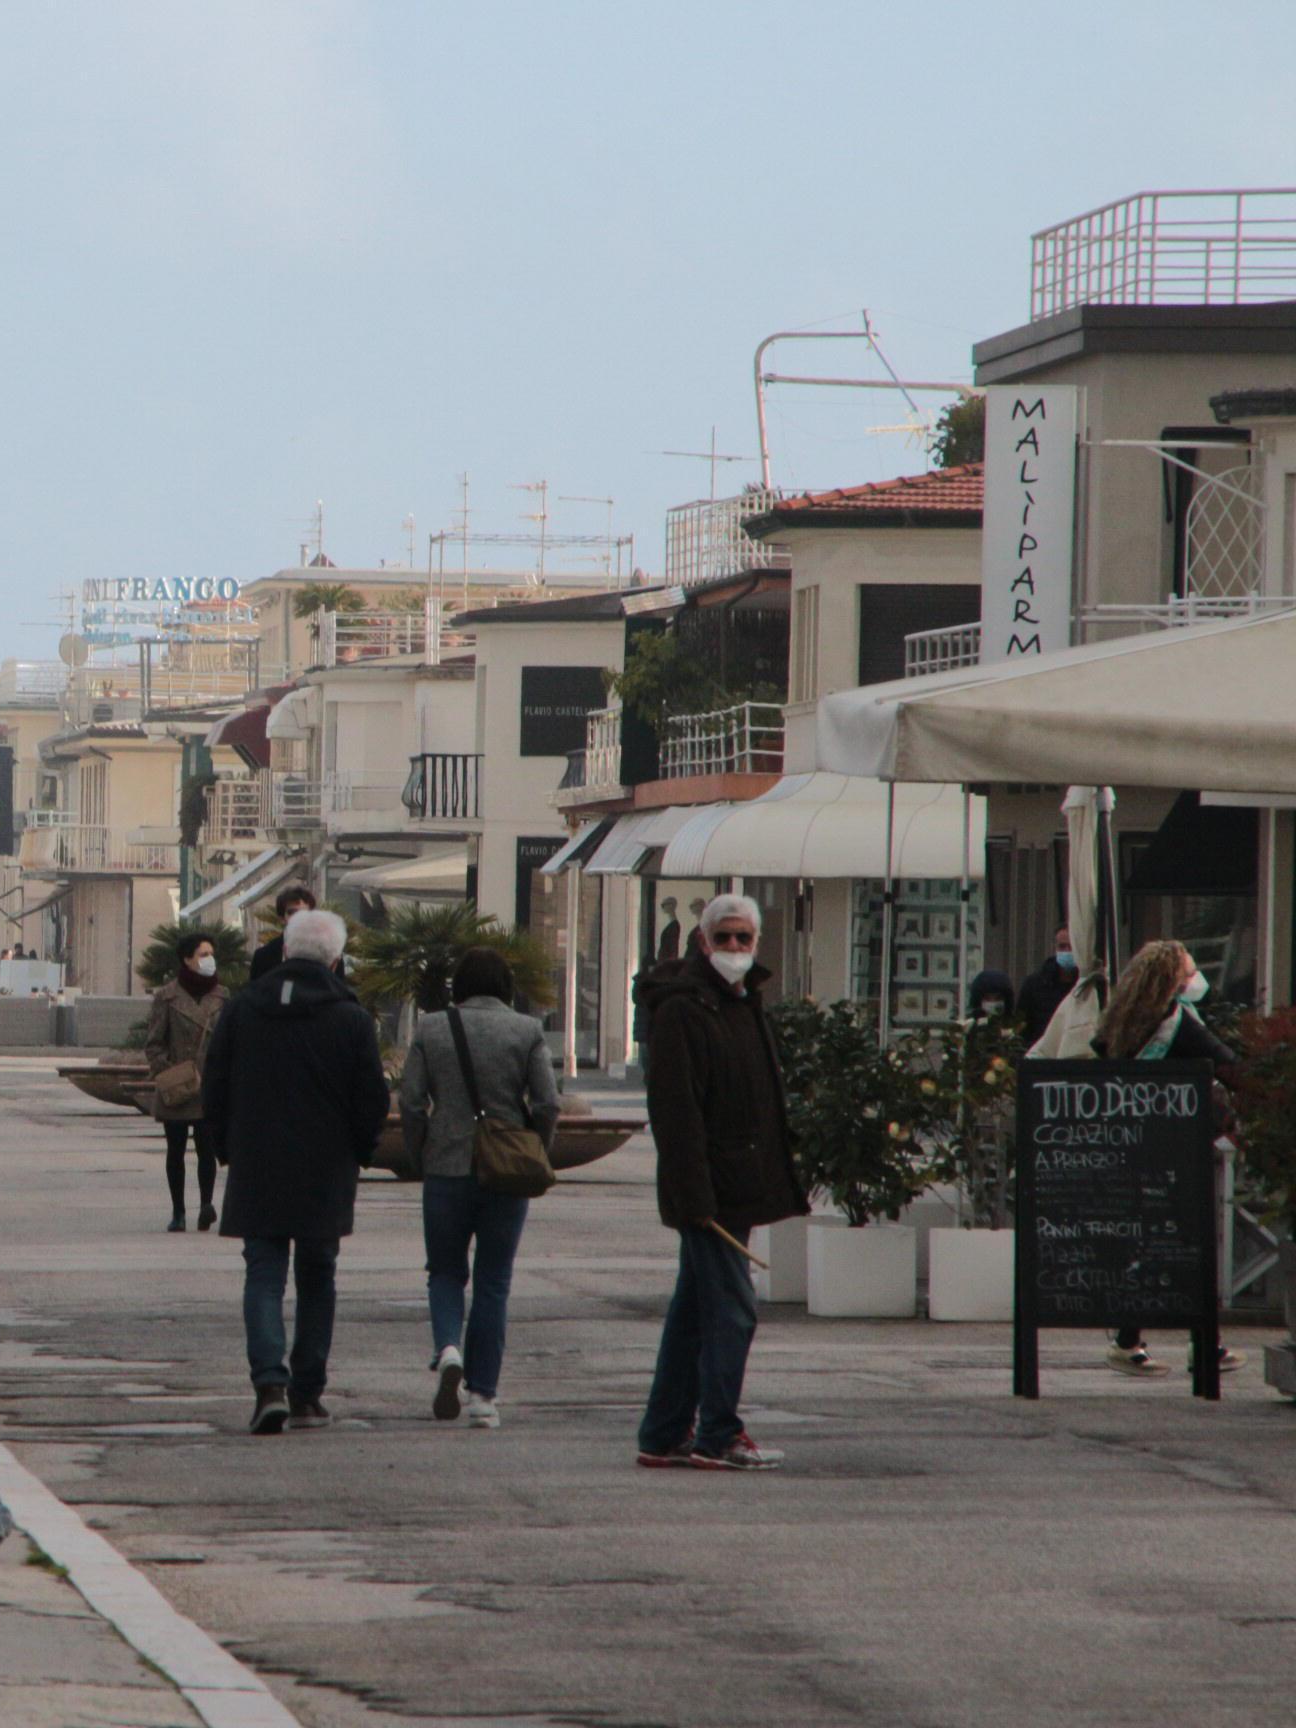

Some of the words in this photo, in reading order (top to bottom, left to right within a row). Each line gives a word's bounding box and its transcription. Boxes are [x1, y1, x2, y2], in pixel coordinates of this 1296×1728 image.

[524, 705, 552, 717] FLAVIO
[520, 845, 548, 857] FLAVIO
[1033, 1080, 1099, 1120] TUTTO
[1033, 1118, 1144, 1146] COLAZIONI
[1035, 1151, 1049, 1169] A
[1164, 1219, 1178, 1233] 5
